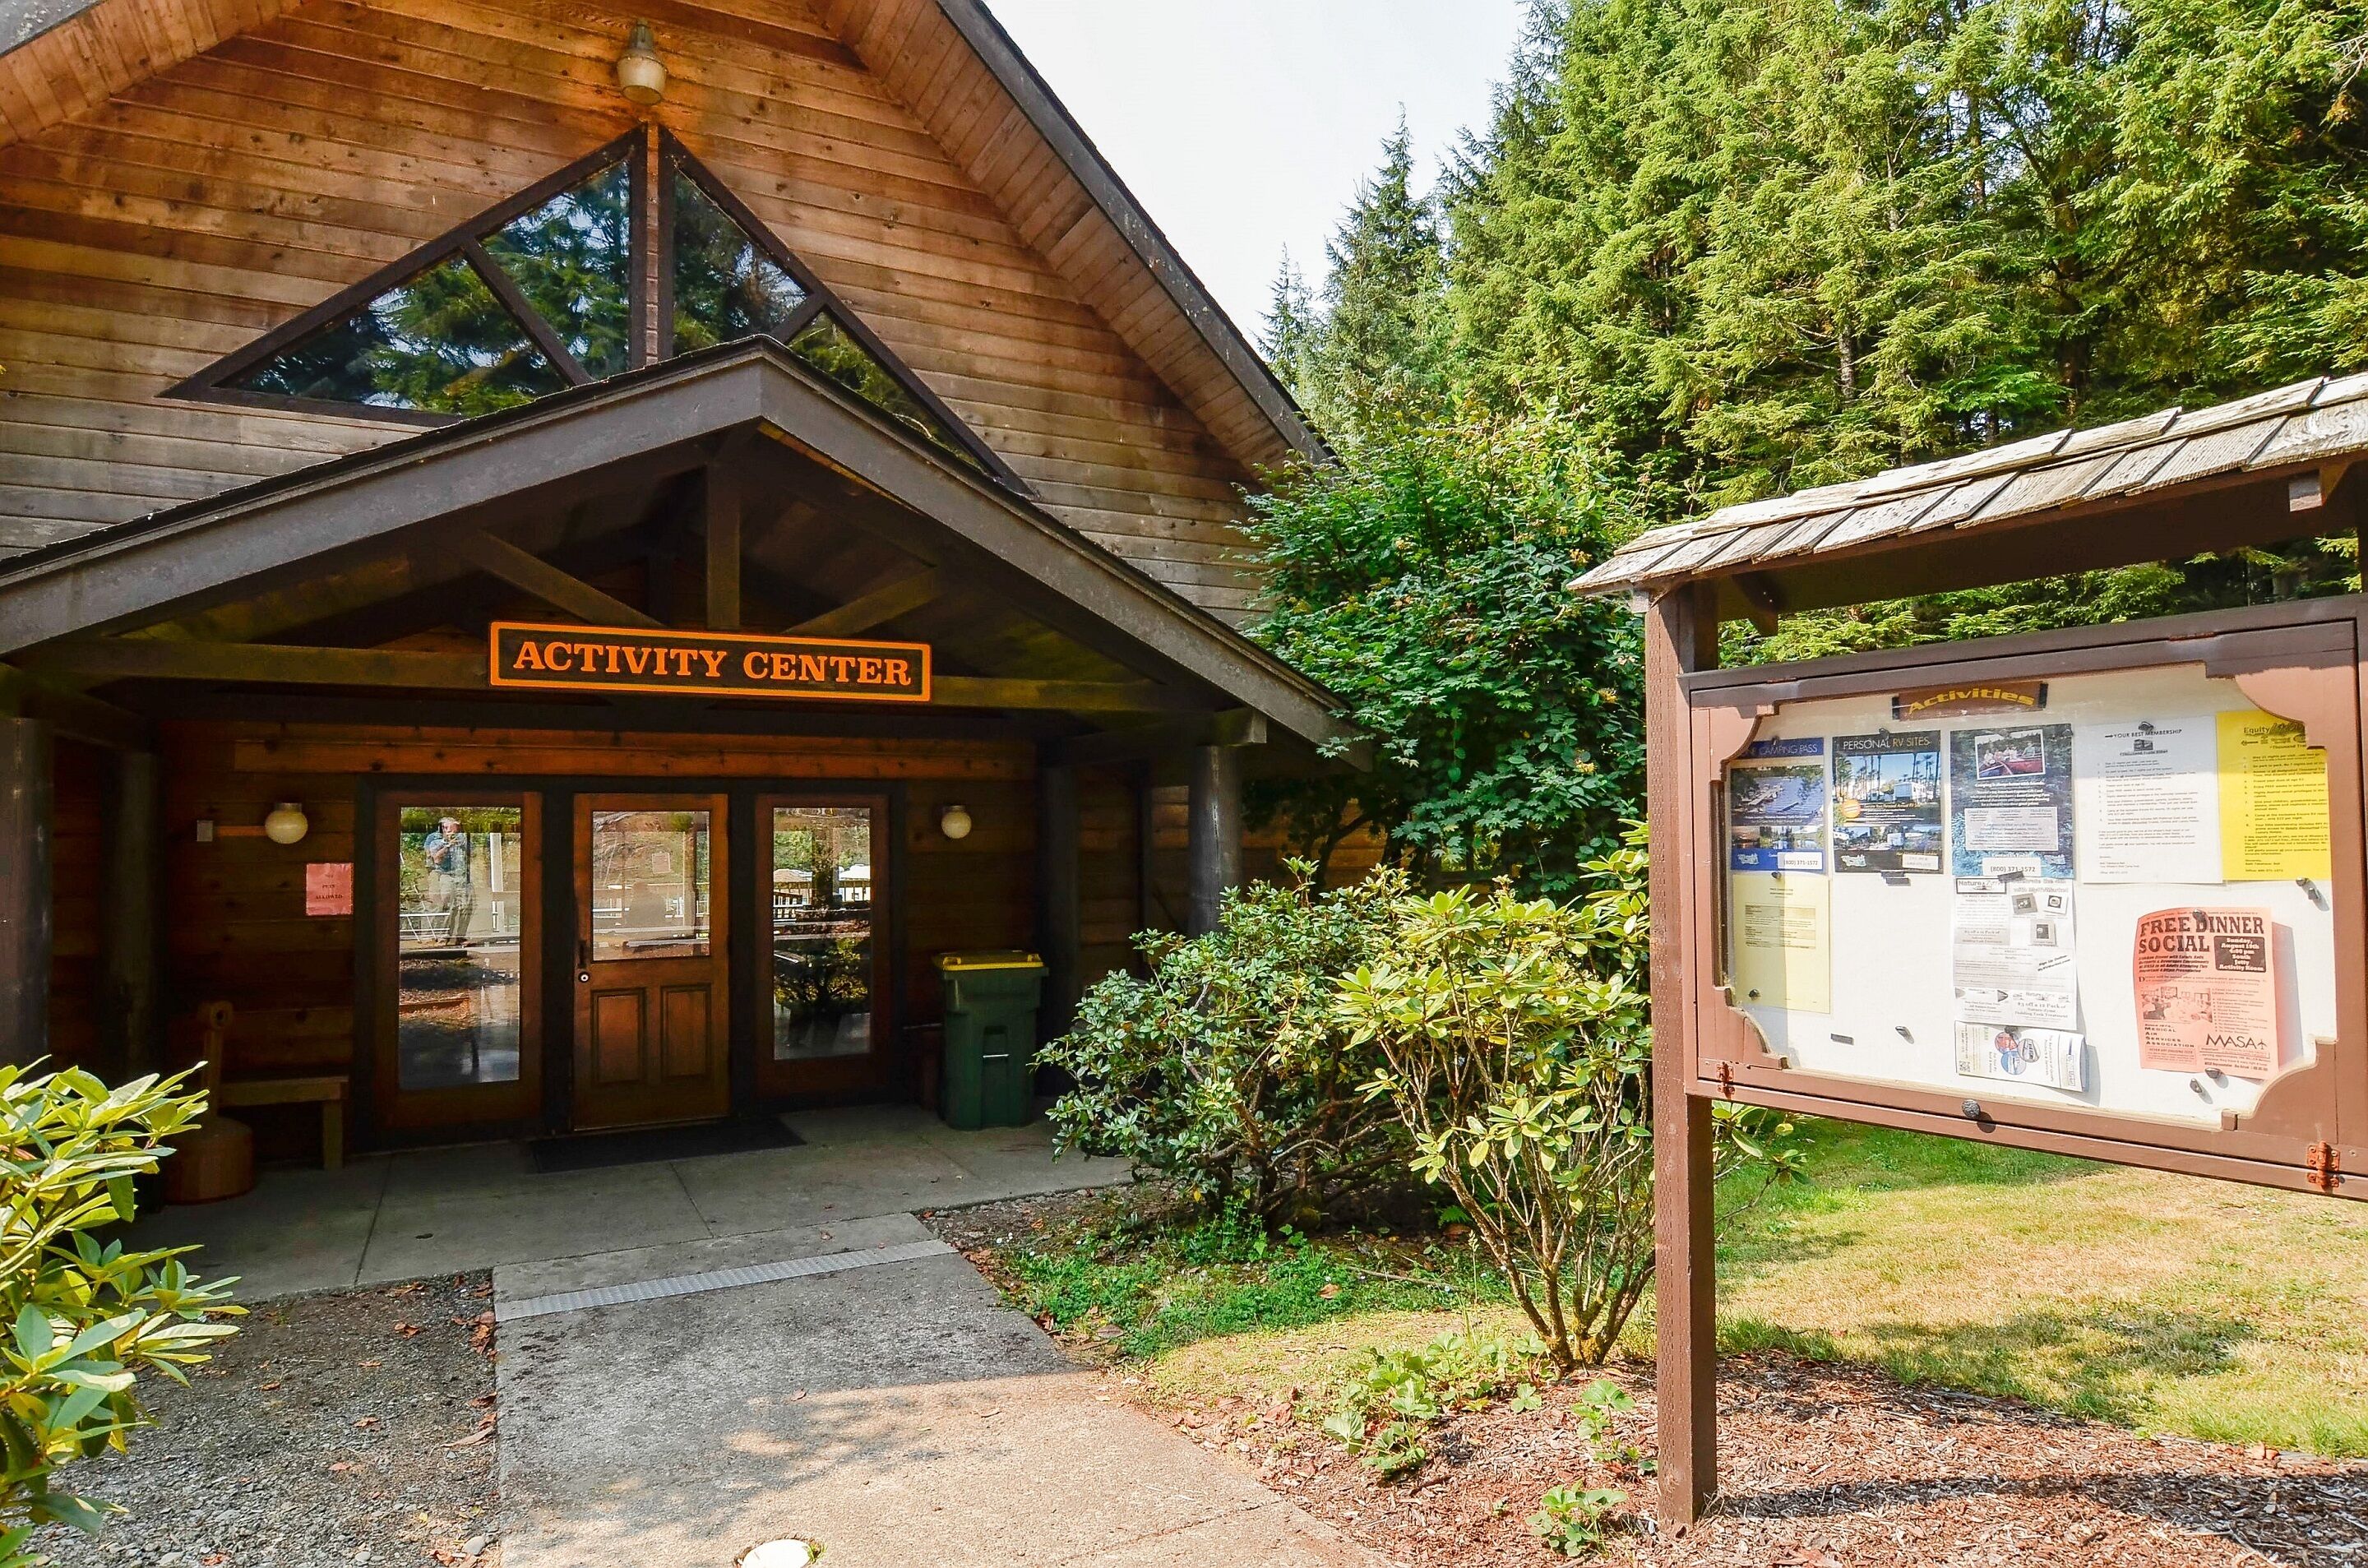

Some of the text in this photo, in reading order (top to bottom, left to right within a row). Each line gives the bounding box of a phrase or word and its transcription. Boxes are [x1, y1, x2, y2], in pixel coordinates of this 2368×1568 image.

[512, 640, 912, 687] ACTIVITY CENTER
[1908, 687, 2035, 715] Activities
[2144, 728, 2183, 737] MEMBERSHIP
[2243, 726, 2270, 734] Equity
[1799, 743, 1818, 754] PASS
[1843, 737, 1930, 750] PERSONAL RV SITES
[2139, 915, 2264, 937] FREE DINNER
[2138, 935, 2210, 955] SOCIAL
[2218, 964, 2245, 972] Activity
[2205, 1034, 2257, 1049] MASA
